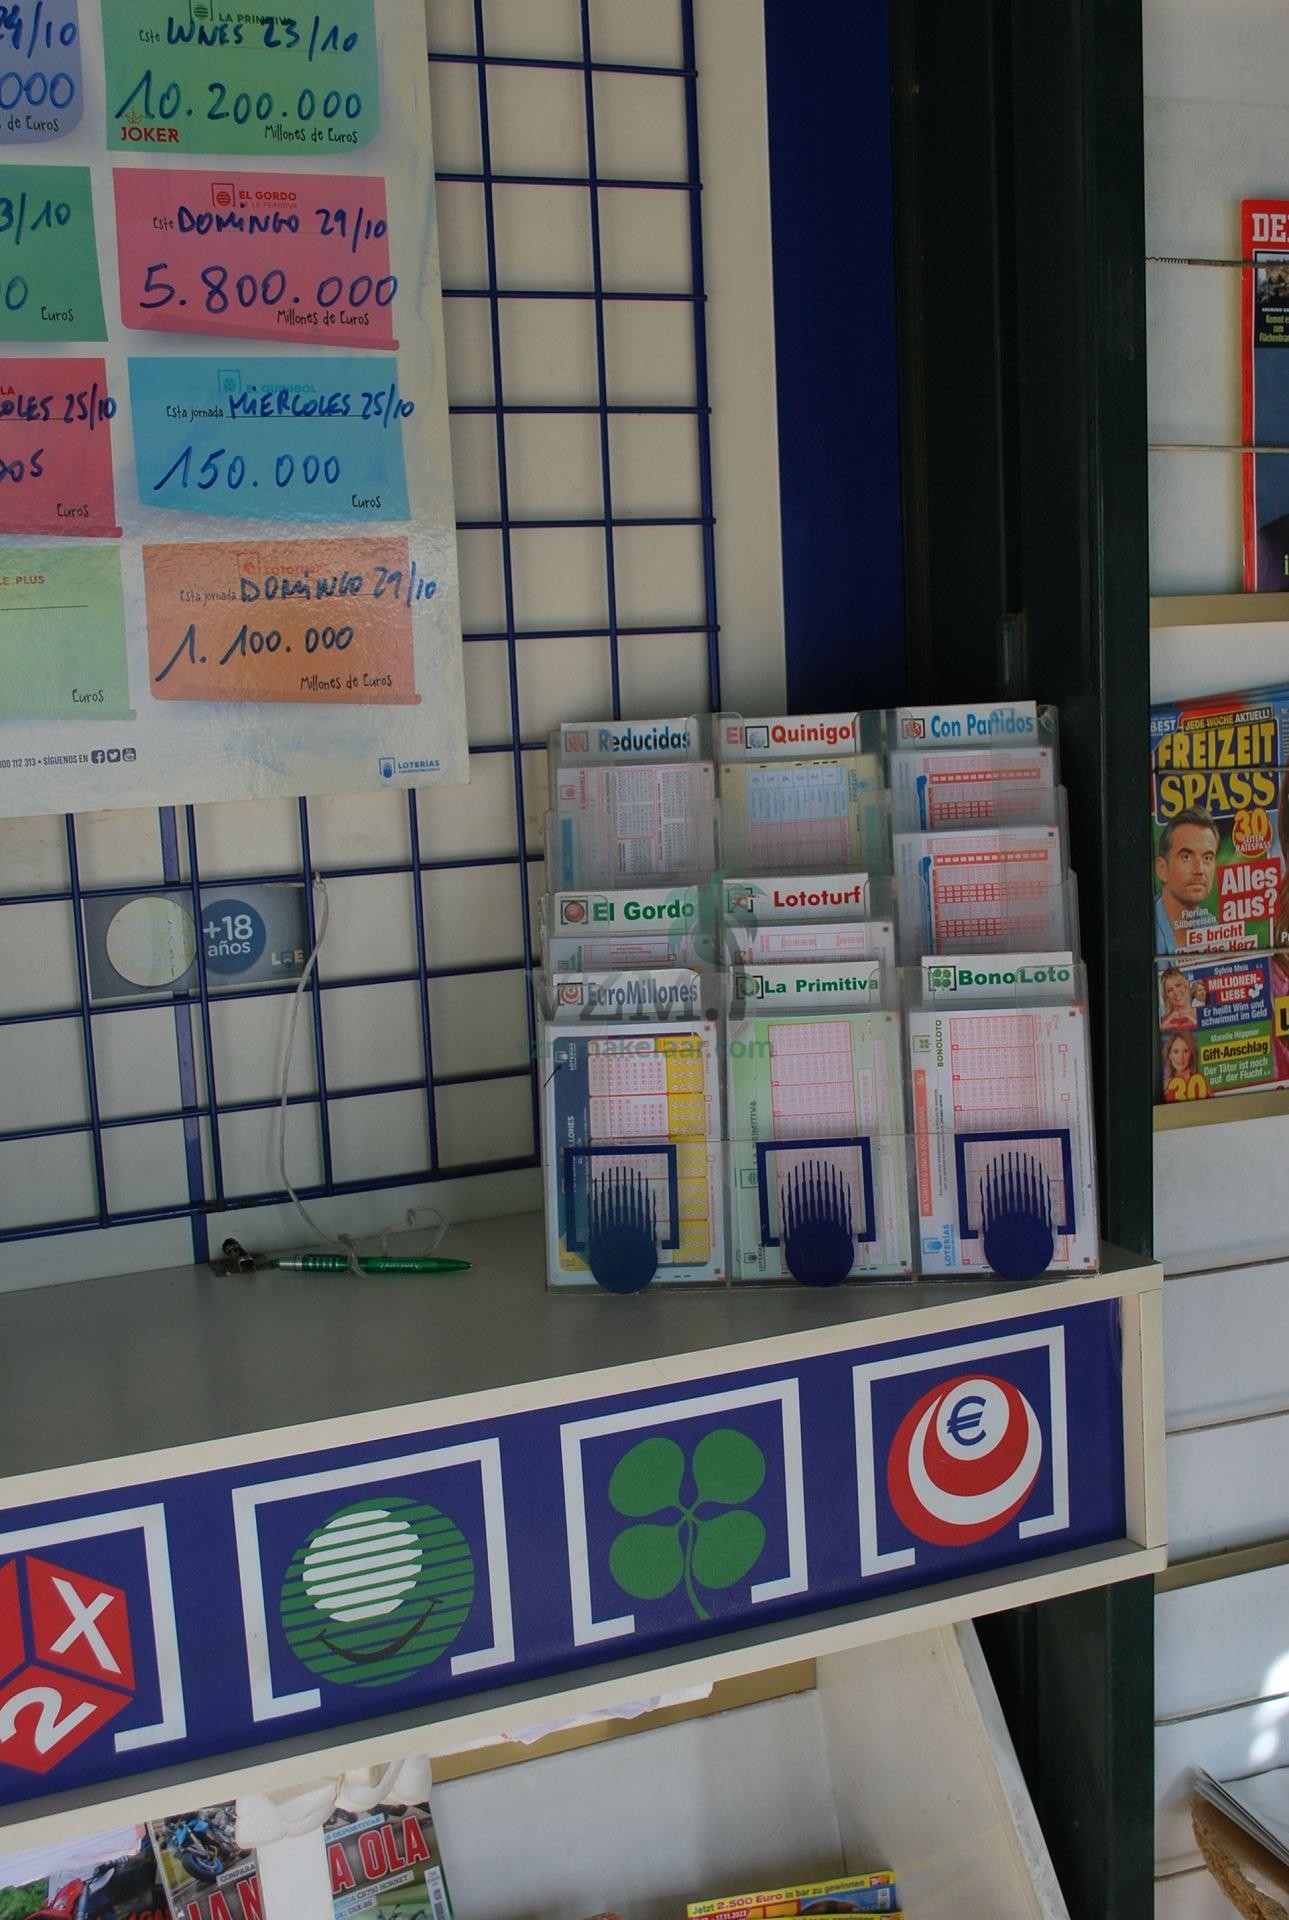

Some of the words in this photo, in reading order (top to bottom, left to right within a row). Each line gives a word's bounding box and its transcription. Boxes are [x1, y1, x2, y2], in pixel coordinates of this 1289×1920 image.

[139, 29, 161, 43] Este
[261, 16, 358, 62] 23/10
[115, 69, 362, 125] 10.200.000
[7, 115, 21, 132] de
[26, 115, 60, 132] Euros
[264, 124, 306, 143] Millones
[310, 128, 324, 142] de
[328, 128, 358, 144] Euros
[120, 126, 179, 143] JOKER
[239, 190, 252, 200] EL
[255, 190, 297, 201] GORDO
[153, 217, 174, 230] Este
[177, 206, 300, 235] DOMINGO
[315, 207, 388, 254] 29/10
[1252, 212, 1289, 243] DE
[139, 262, 399, 315] 5.800.000
[41, 306, 74, 322] Euros
[276, 309, 318, 327] Millones
[322, 309, 335, 326] de
[339, 310, 369, 327] Euros
[63, 382, 117, 431] 25/10
[166, 405, 188, 420] Esta
[188, 406, 224, 423] jornada
[360, 382, 415, 428] 25/10
[153, 445, 340, 491] 150.000
[56, 502, 89, 519] Euros
[351, 493, 382, 509] Euros
[16, 575, 46, 585] PLUS
[372, 560, 437, 608] 29/10
[155, 623, 354, 683] 1.100.000
[300, 674, 342, 691] Millones
[346, 674, 359, 689] de
[363, 673, 392, 688] Euros
[72, 688, 104, 704] Euros
[931, 715, 962, 738] Con
[966, 708, 1034, 737] Partidos
[1150, 719, 1176, 733] BEST
[1185, 719, 1205, 731] JEDE
[1206, 714, 1234, 728] WOCHE
[1235, 708, 1271, 724] AKTUELL!
[598, 726, 691, 753] Reducidas
[726, 726, 743, 745] El
[770, 721, 856, 745] Quinigol
[1158, 721, 1275, 769] FREIZEIT
[79, 754, 88, 764] EN
[1160, 770, 1276, 818] SPASS
[1235, 807, 1269, 841] 30
[1221, 864, 1279, 896] Alles
[774, 886, 861, 908] Lototurf
[1222, 888, 1278, 922] aus?
[593, 902, 615, 922] El
[624, 900, 695, 921] Gordo
[1182, 907, 1209, 920] Florian
[203, 914, 253, 941] +18
[1189, 931, 1203, 945] Es
[1206, 924, 1243, 943] bricht
[207, 941, 251, 958] años
[1228, 939, 1257, 952] Herz
[764, 979, 786, 994] La
[796, 977, 880, 993] Primitiva
[1208, 973, 1261, 990] MILLIONEN-
[588, 979, 699, 1008] EuroMillones
[1220, 988, 1246, 1002] LIEBE
[1201, 1013, 1240, 1027] schwimmt
[1240, 1011, 1250, 1020] im
[1251, 1008, 1267, 1018] Geld
[1203, 1008, 1211, 1017] Er
[1250, 999, 1264, 1010] und
[936, 1018, 944, 1069] BONOLOTO
[1202, 1041, 1268, 1061] Gift-Anschlag
[1203, 1066, 1217, 1077] Der
[1219, 1062, 1237, 1074] Täter
[1239, 1060, 1249, 1070] ist
[1250, 1057, 1268, 1069] noch
[1209, 1075, 1222, 1085] auf
[1225, 1072, 1238, 1082] der
[943, 1222, 951, 1267] LOTERÍAS
[49, 1576, 122, 1674] X
[358, 1815, 431, 1880] OLA
[692, 1903, 714, 1915] Jetzt
[716, 1897, 753, 1911] 2.500
[755, 1890, 783, 1904] Euro
[785, 1890, 793, 1899] in
[795, 1888, 810, 1898] bar
[812, 1886, 824, 1896] zu
[825, 1879, 866, 1895] gewinnen
